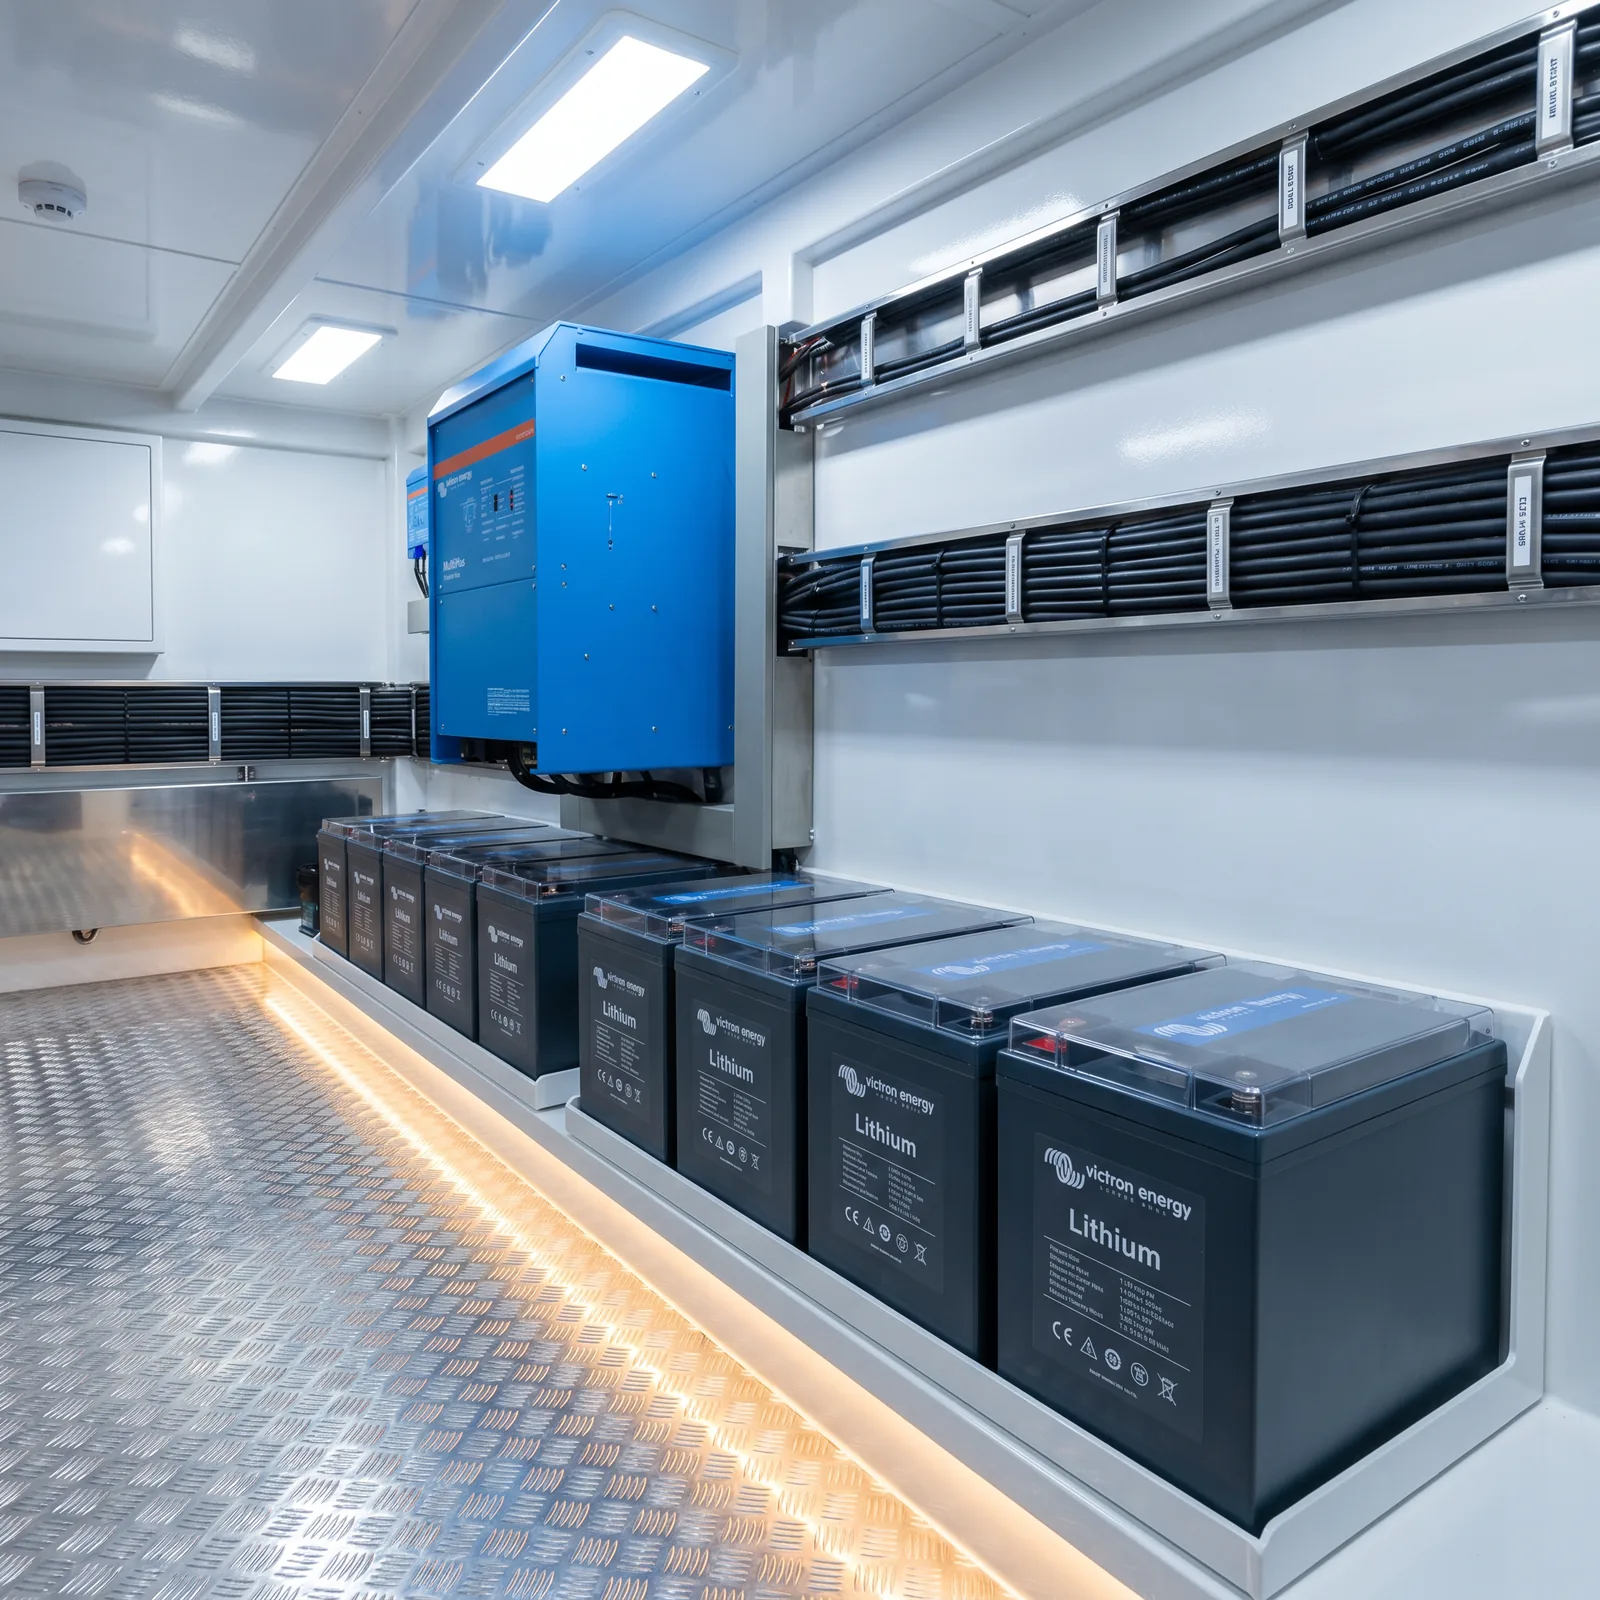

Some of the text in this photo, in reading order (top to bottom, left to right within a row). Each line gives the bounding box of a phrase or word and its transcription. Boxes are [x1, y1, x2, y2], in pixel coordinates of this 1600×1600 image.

[603, 1000, 637, 1030] Lithium
[716, 1015, 766, 1047] victron energy
[709, 1048, 754, 1084] Lithium
[866, 1075, 898, 1098] victron
[899, 1090, 935, 1116] energy
[855, 1112, 917, 1159] Lithium
[1086, 1164, 1134, 1195] victron
[1138, 1186, 1192, 1221] energy
[1069, 1207, 1161, 1271] Lithium
